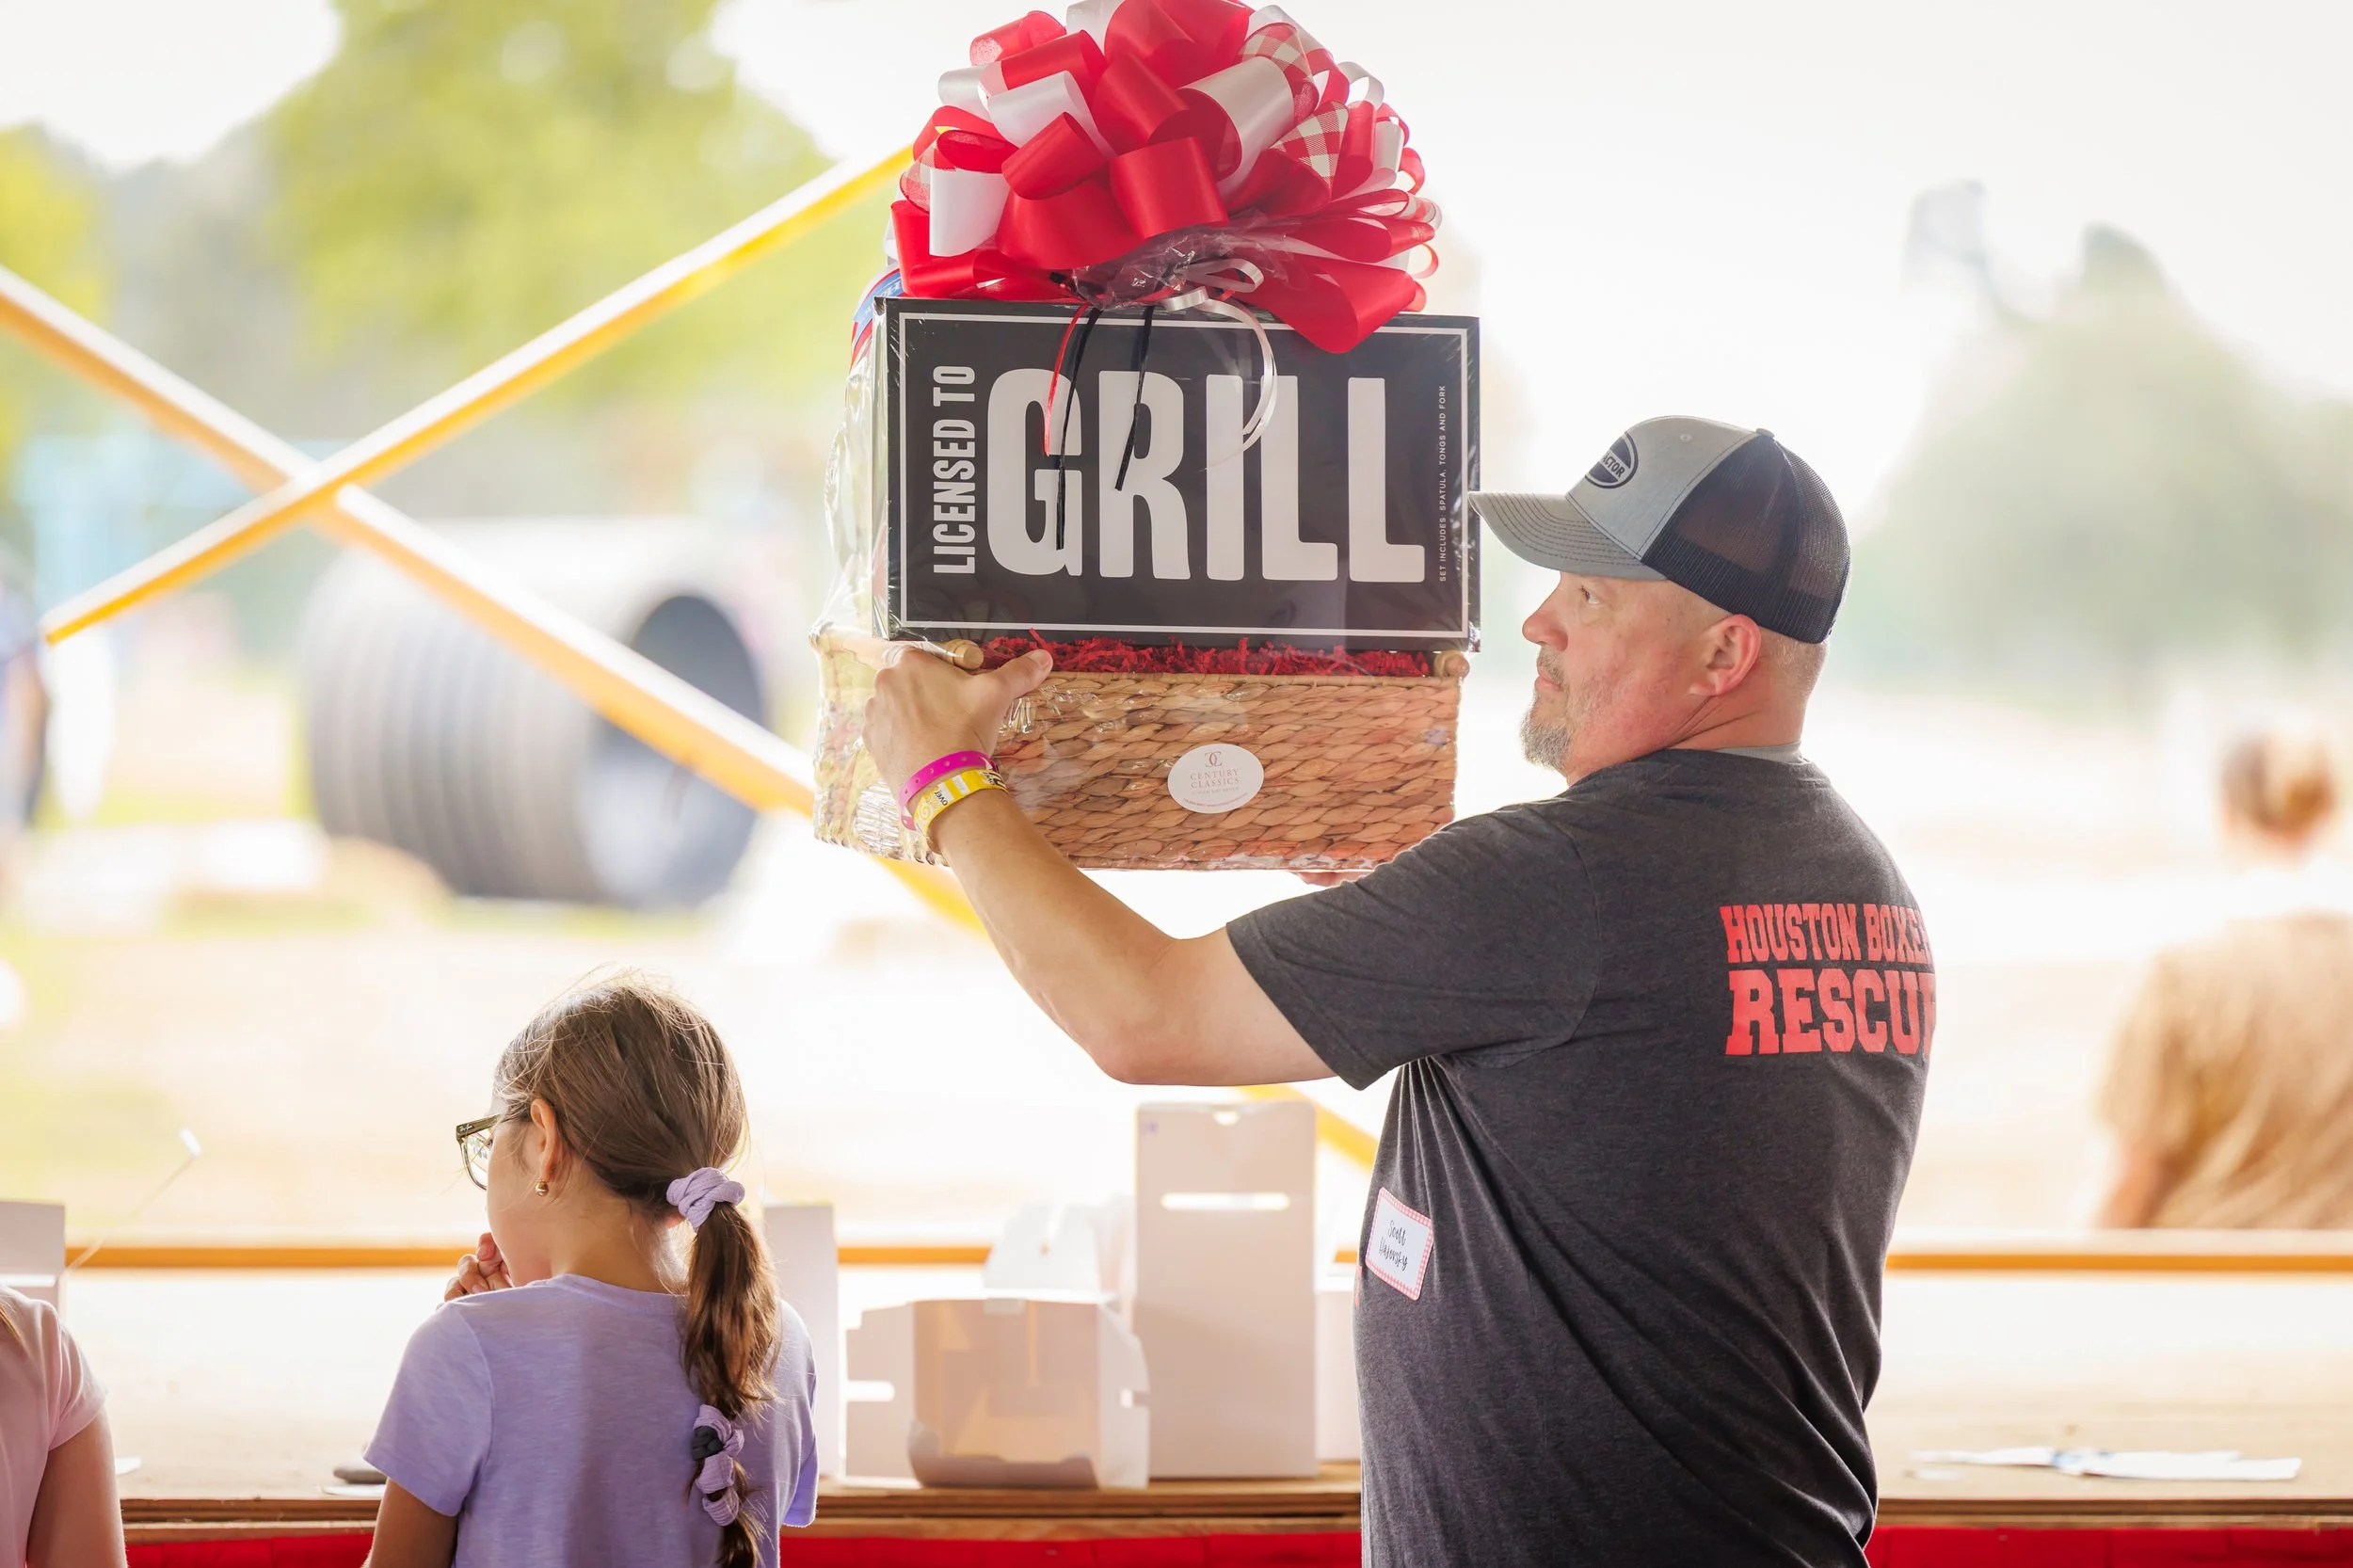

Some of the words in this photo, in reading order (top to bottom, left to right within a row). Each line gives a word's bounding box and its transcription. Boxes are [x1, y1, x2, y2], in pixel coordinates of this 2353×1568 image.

[933, 365, 976, 407] TO
[1438, 385, 1447, 409] FORK
[1438, 412, 1447, 431] AND
[1438, 435, 1447, 465] TONGS
[986, 368, 1425, 584] GRILL
[933, 419, 976, 574] LICENSED
[1190, 768, 1240, 781] CENTURY
[1191, 776, 1240, 790] CLASSICS
[1719, 903, 1862, 964] HOUSTON
